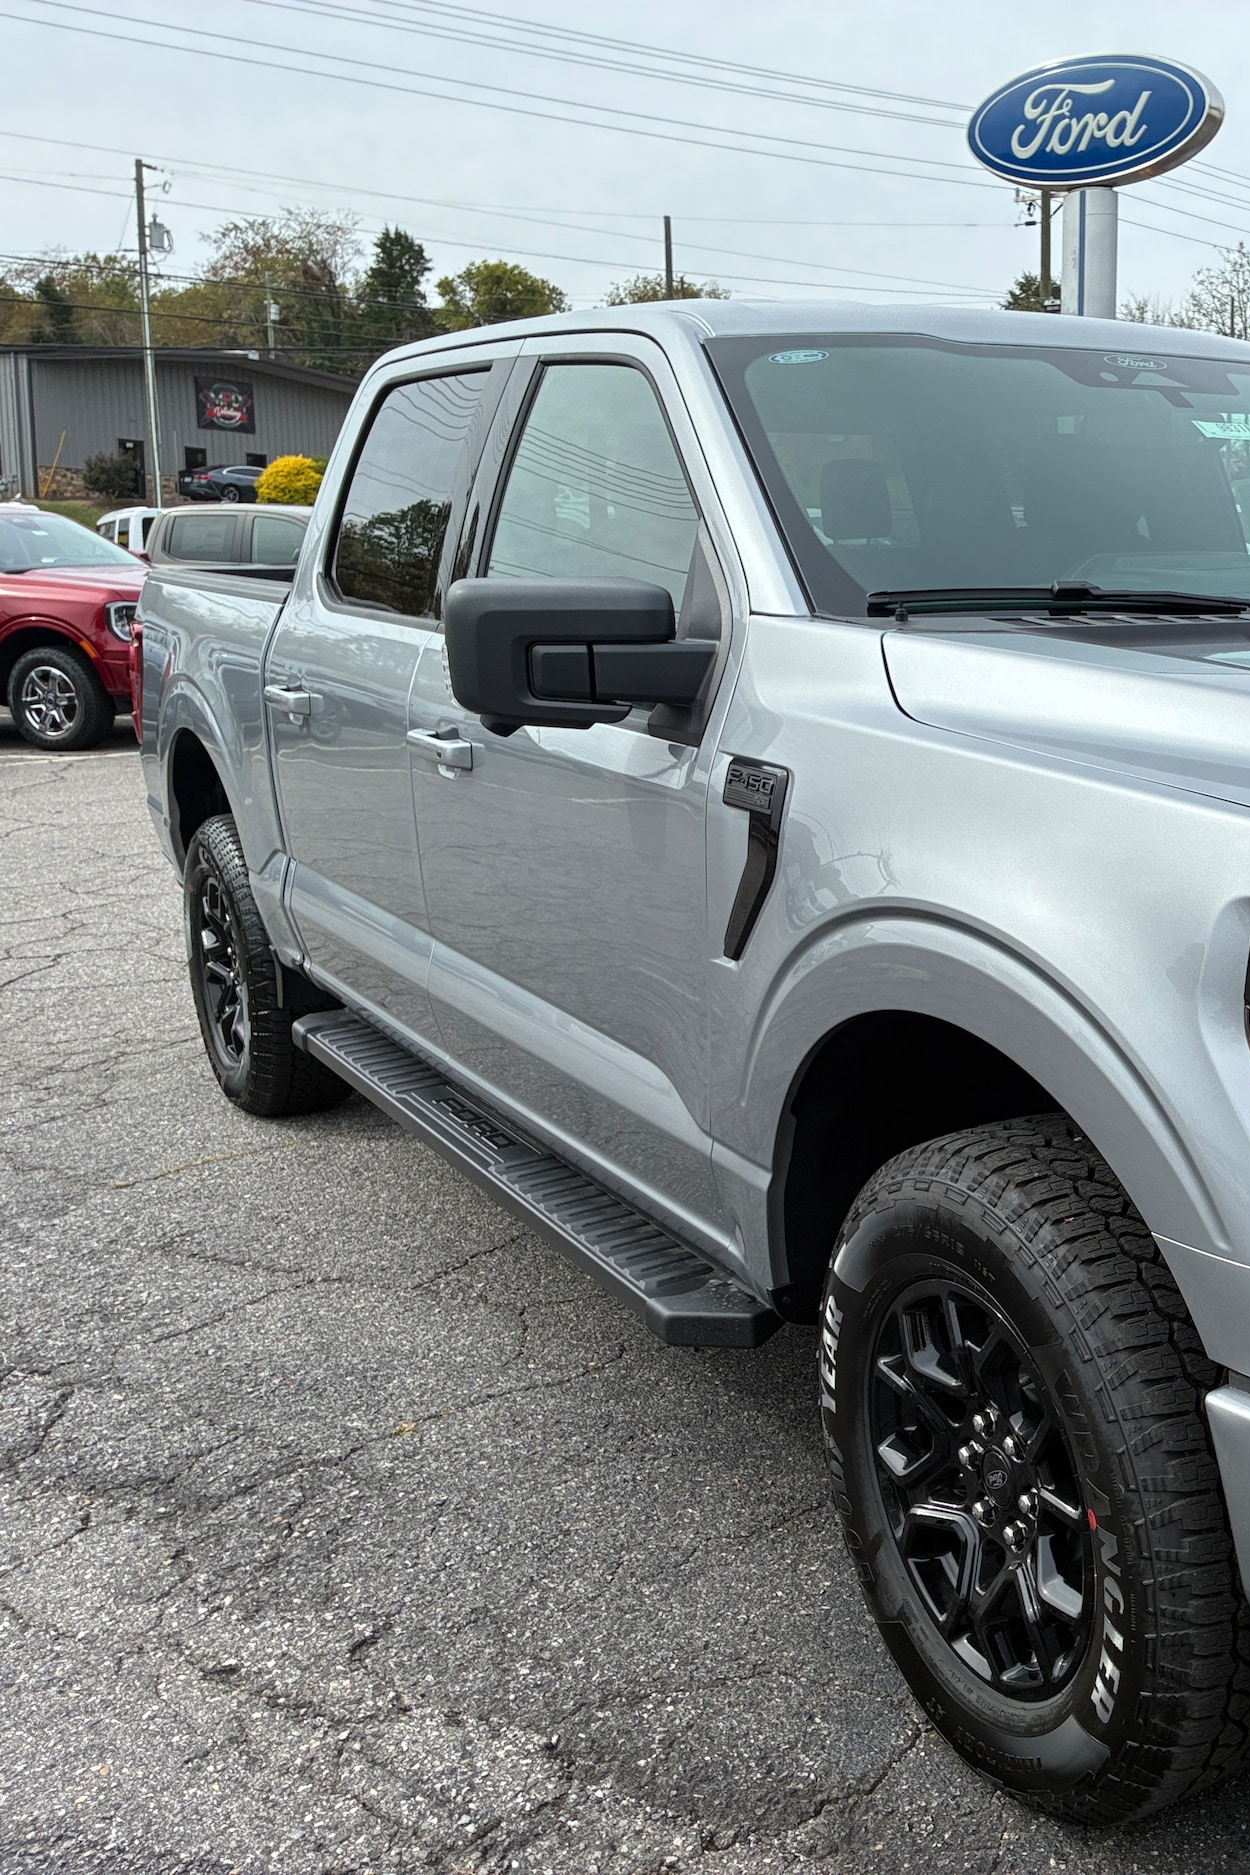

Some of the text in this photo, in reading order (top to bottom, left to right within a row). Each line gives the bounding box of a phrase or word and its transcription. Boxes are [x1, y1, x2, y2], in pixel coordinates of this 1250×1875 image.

[1011, 79, 1153, 160] Ford
[1116, 355, 1158, 369] Ford
[727, 767, 776, 796] F-150
[431, 1098, 518, 1150] FORD
[1054, 1368, 1125, 1724] WRANGLER
